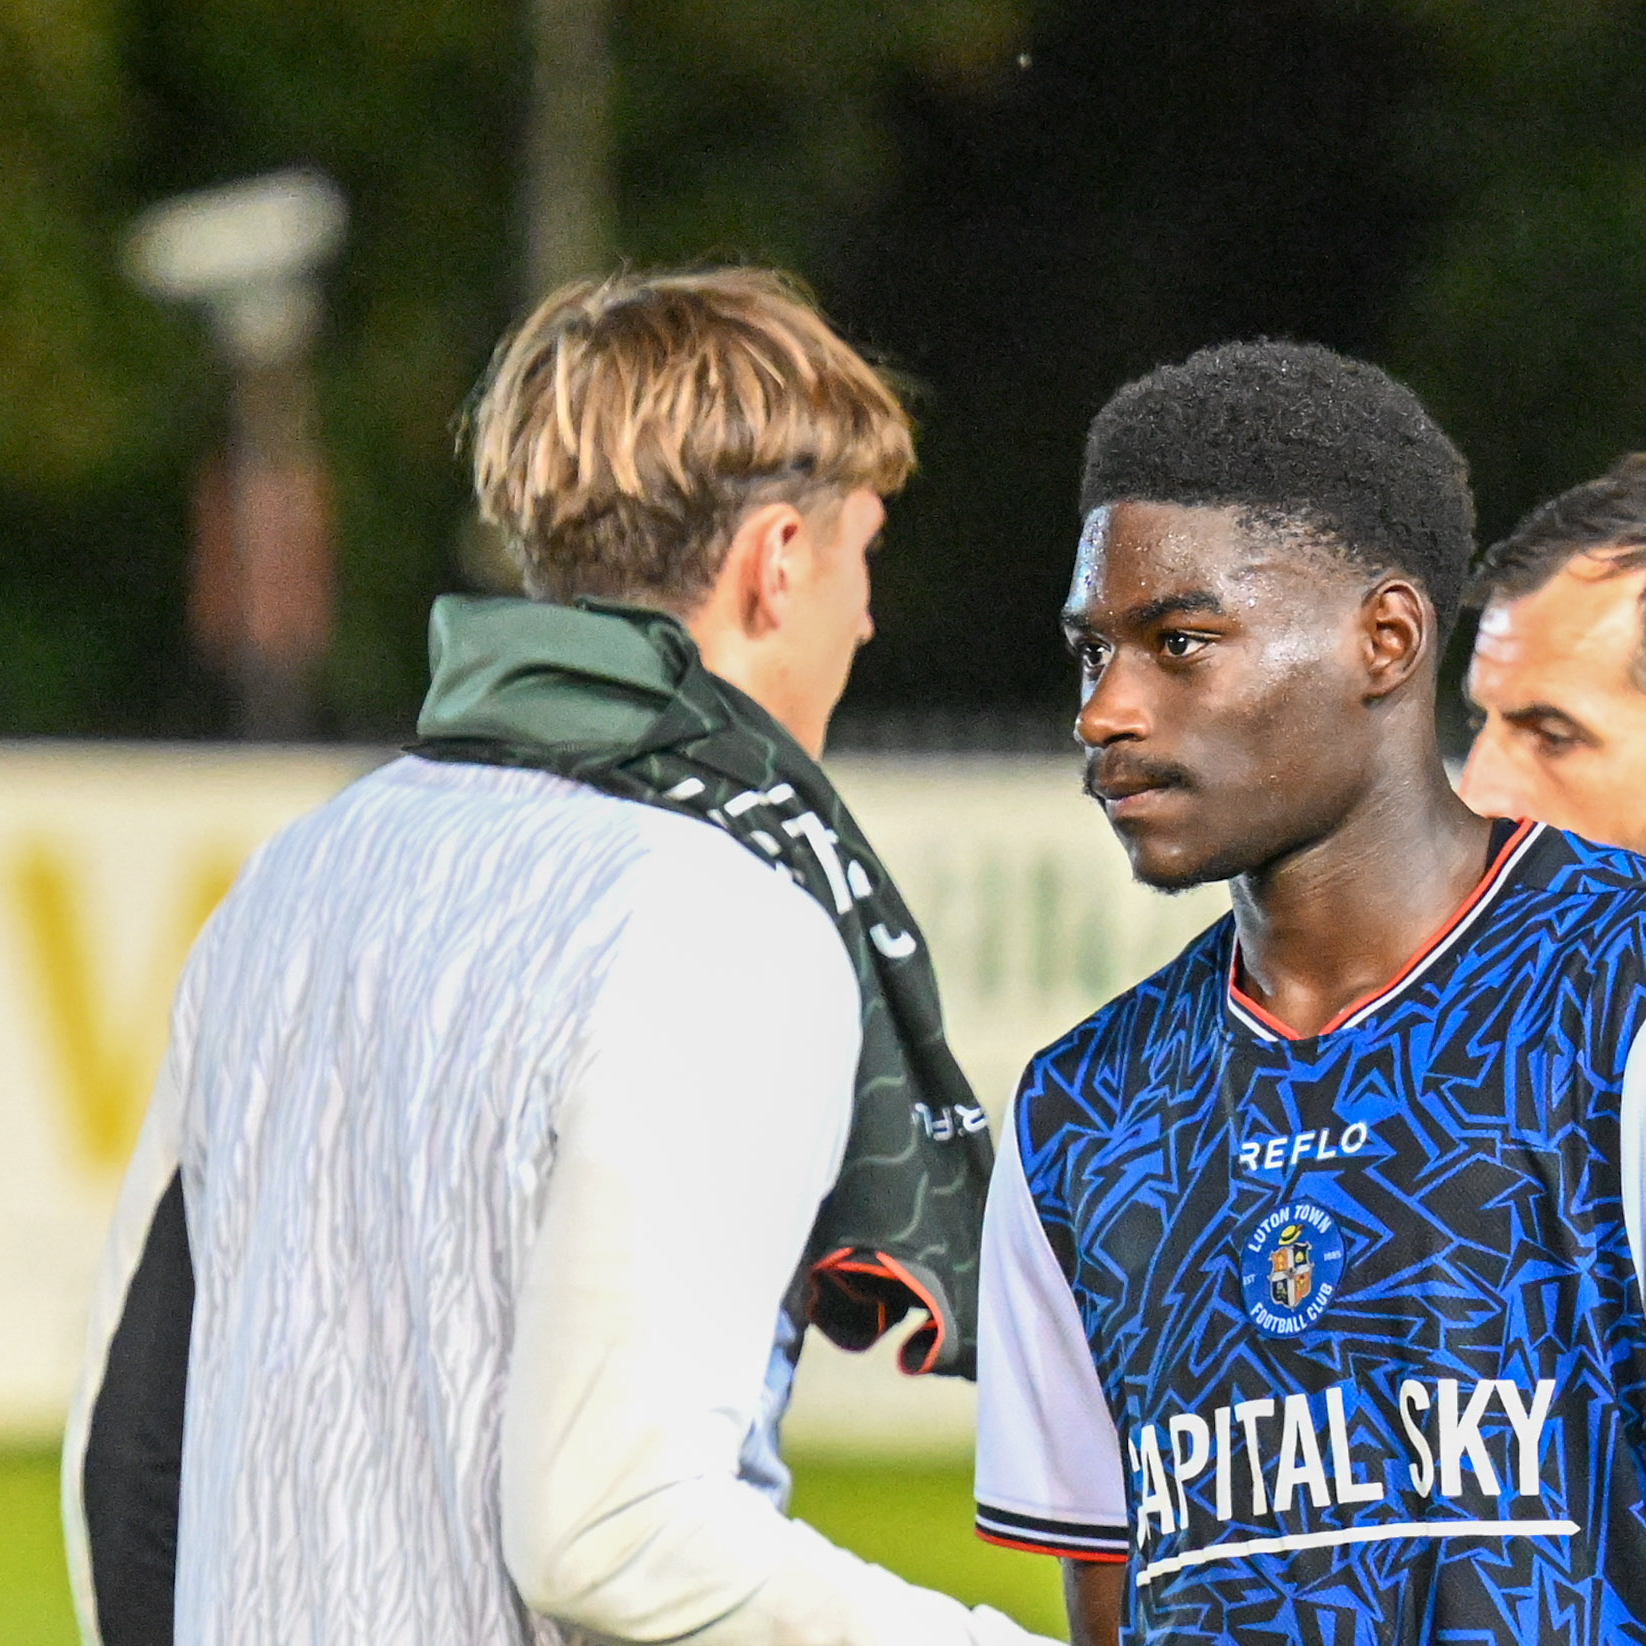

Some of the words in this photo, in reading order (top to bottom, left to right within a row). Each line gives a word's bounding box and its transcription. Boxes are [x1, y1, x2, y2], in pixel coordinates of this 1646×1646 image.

[1239, 1121, 1368, 1171] REFLO
[1248, 1206, 1290, 1253] LUTON
[1294, 1204, 1332, 1235] TOWN
[1250, 1302, 1307, 1334] FOOTBALL
[1306, 1282, 1333, 1321] CLUB
[1400, 1379, 1556, 1498] SKY
